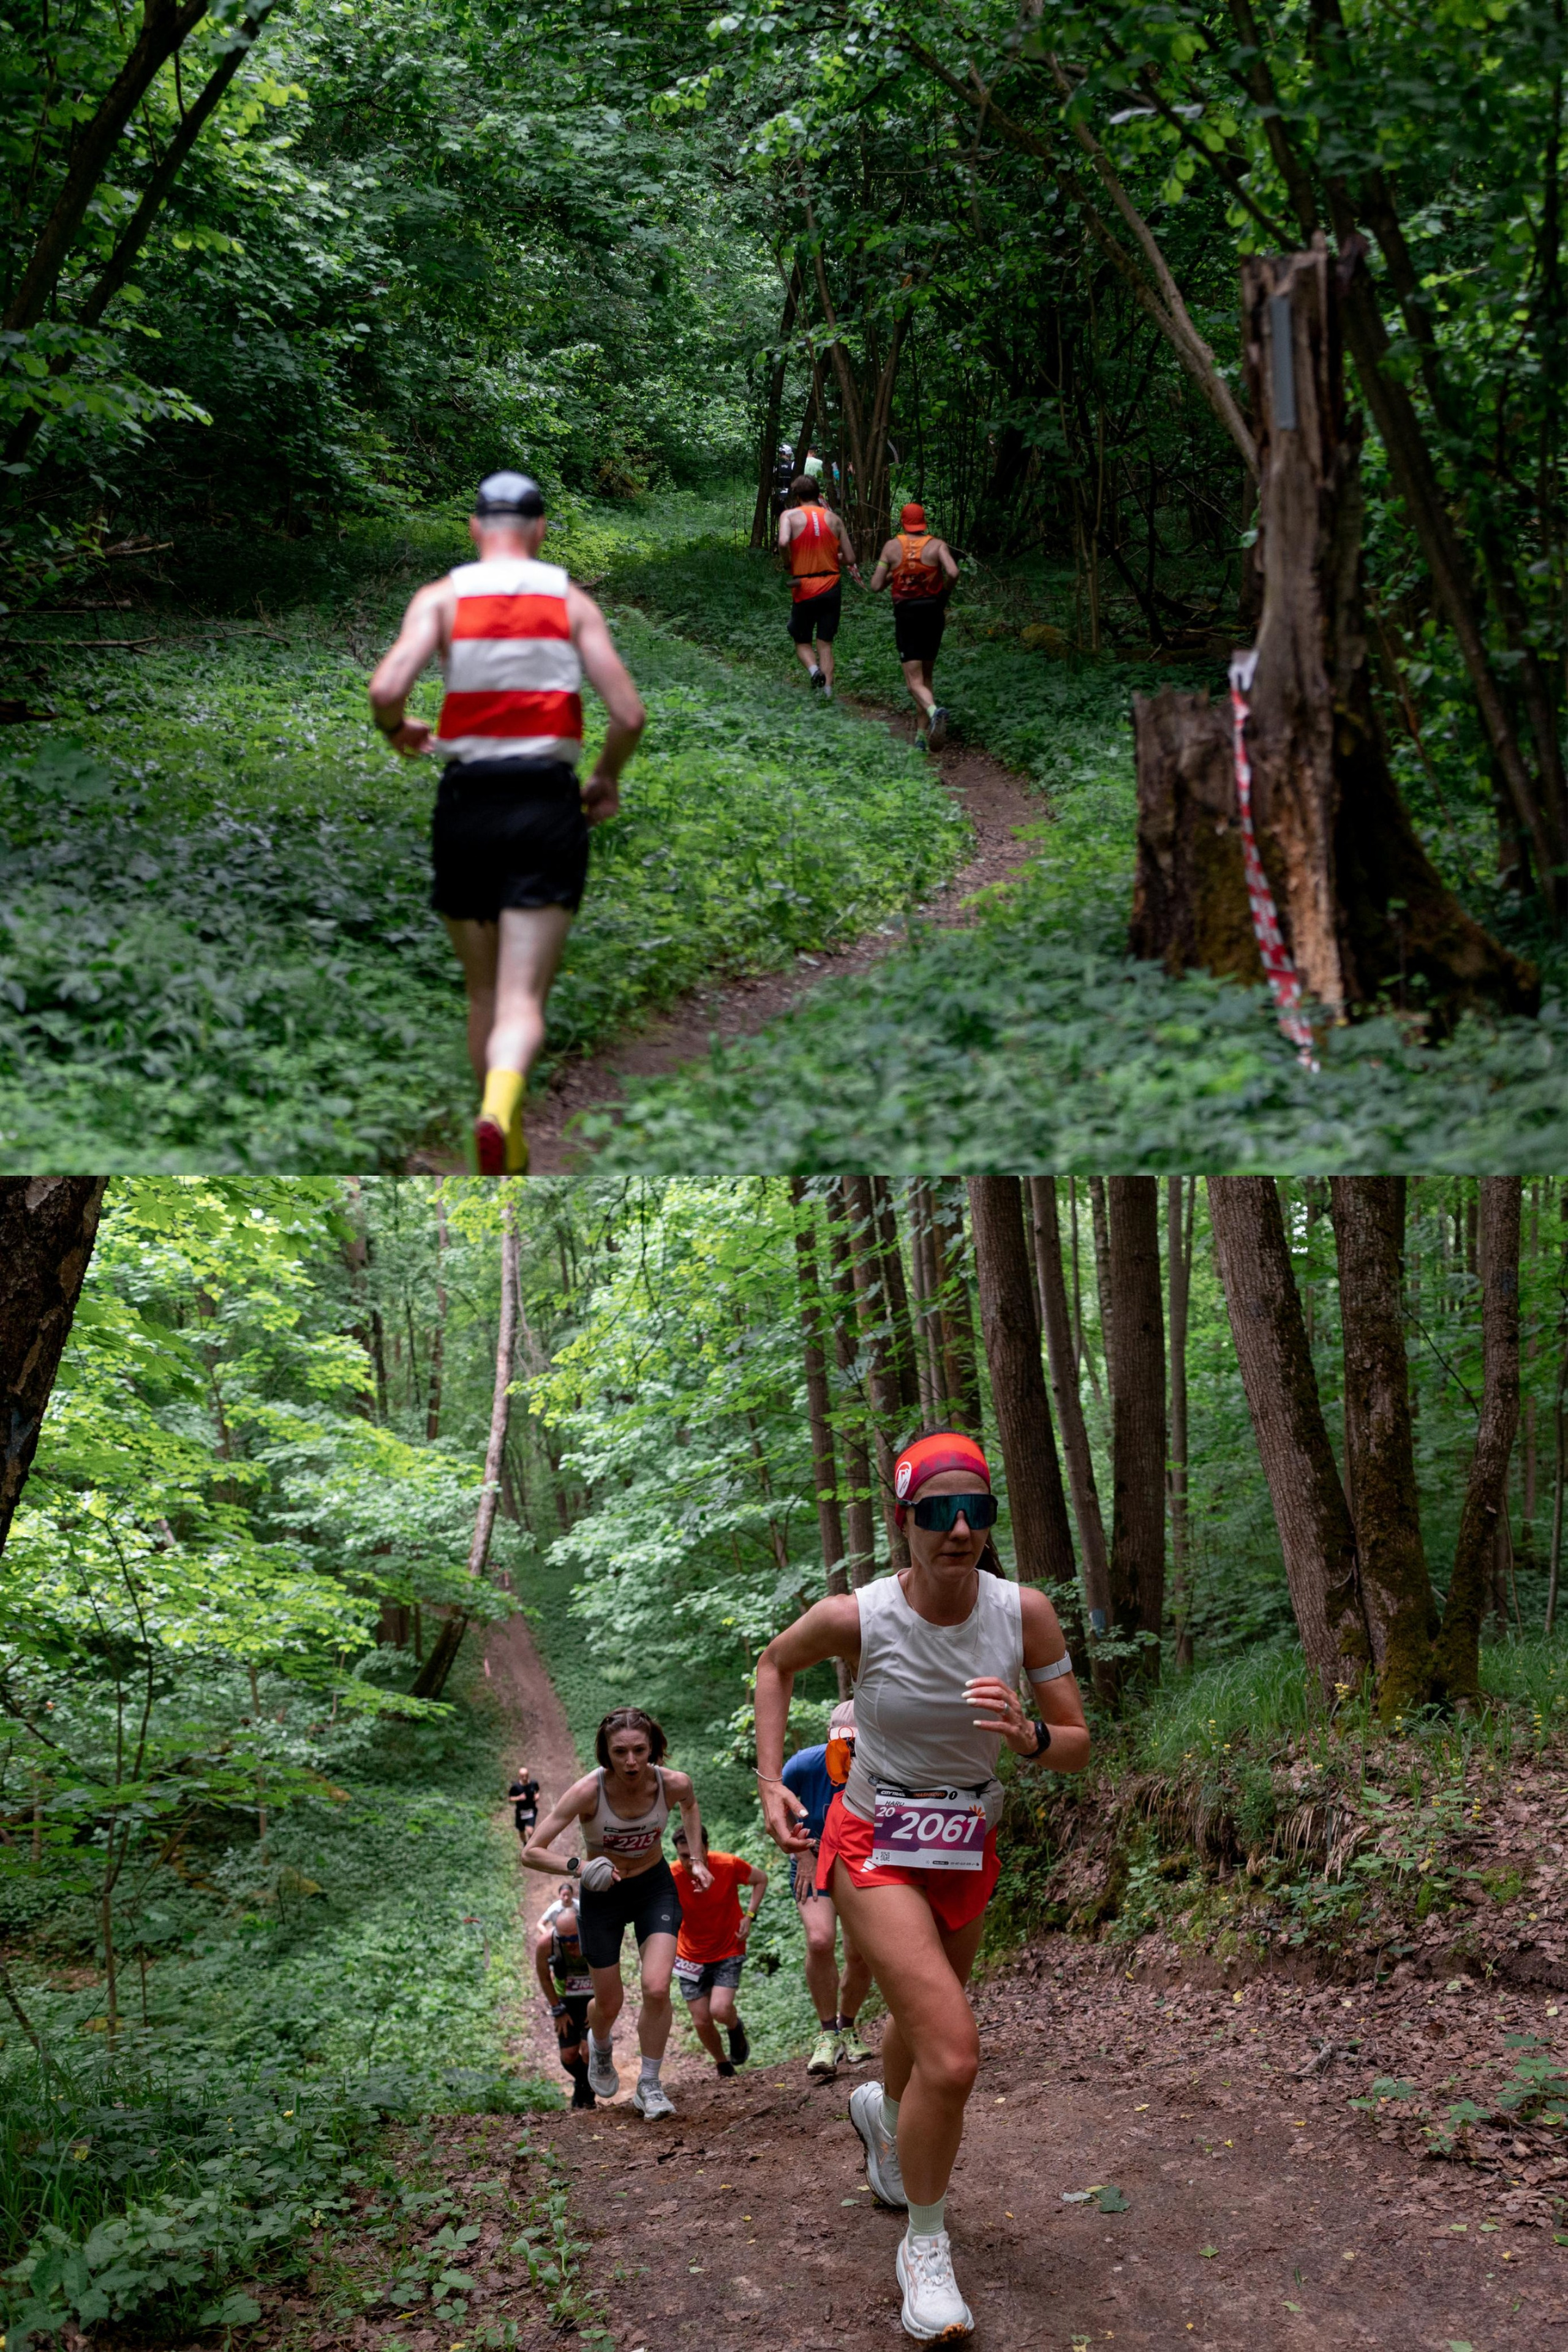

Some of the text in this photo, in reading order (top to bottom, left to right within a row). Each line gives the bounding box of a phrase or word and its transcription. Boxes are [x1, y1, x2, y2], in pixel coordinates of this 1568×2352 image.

[876, 1806, 979, 1844] 20 2061
[613, 1831, 658, 1849] 2213
[676, 1958, 703, 1972] 2057
